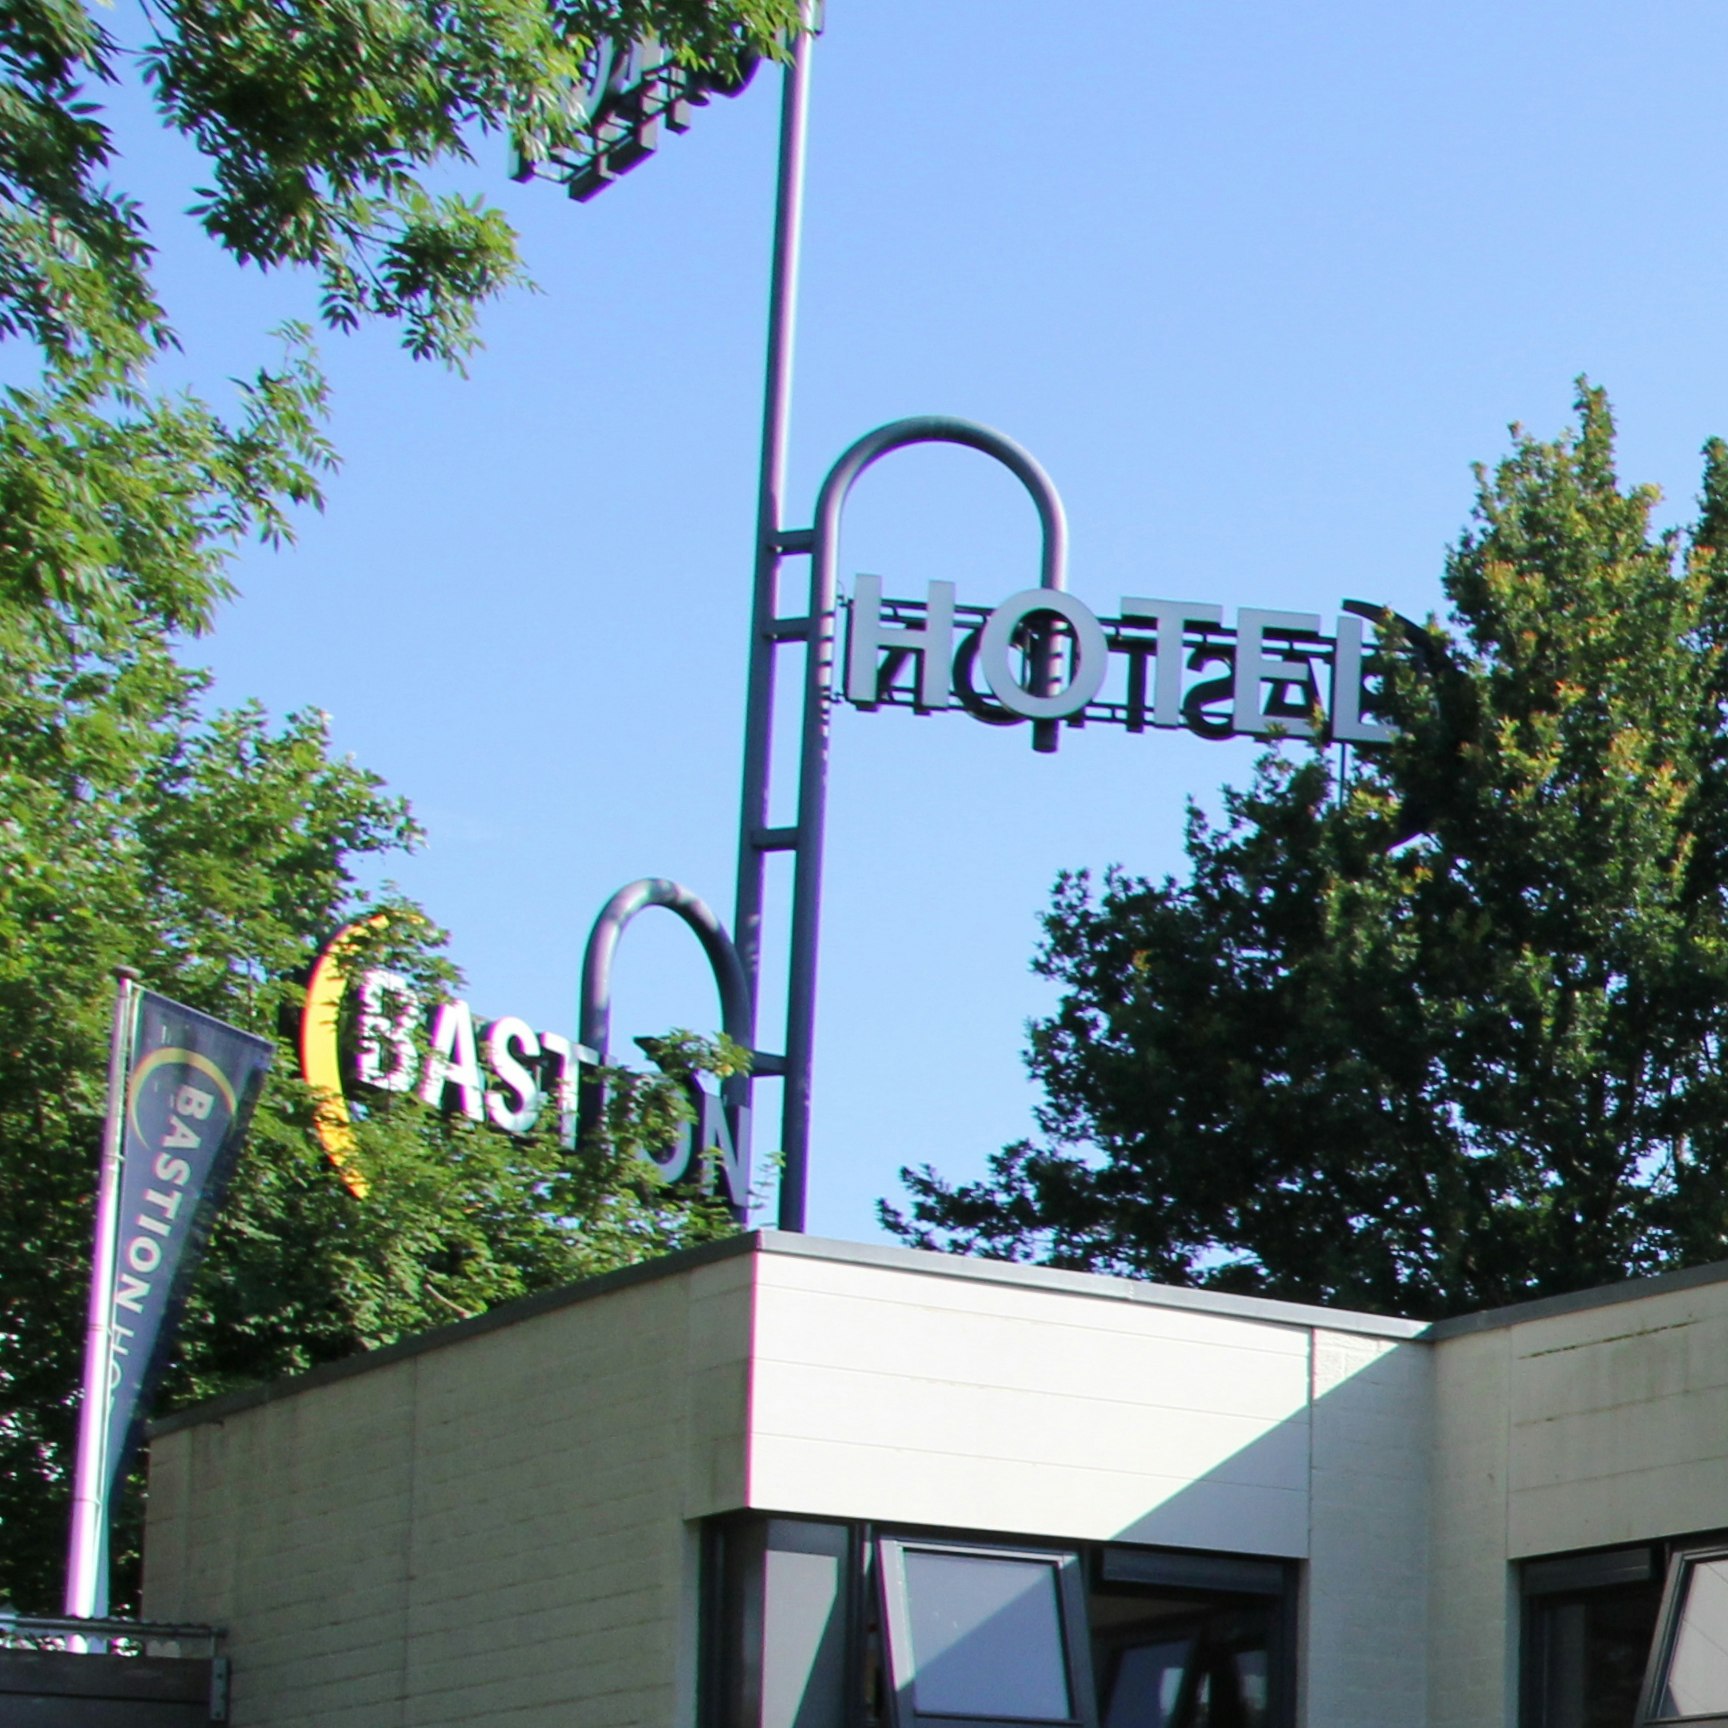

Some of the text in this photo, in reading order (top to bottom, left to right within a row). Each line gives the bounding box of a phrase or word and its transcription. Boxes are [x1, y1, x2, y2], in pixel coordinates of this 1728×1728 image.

[847, 573, 1402, 743] HOTEL
[115, 1083, 216, 1314] BASTION
[357, 968, 751, 1207] BASTON
